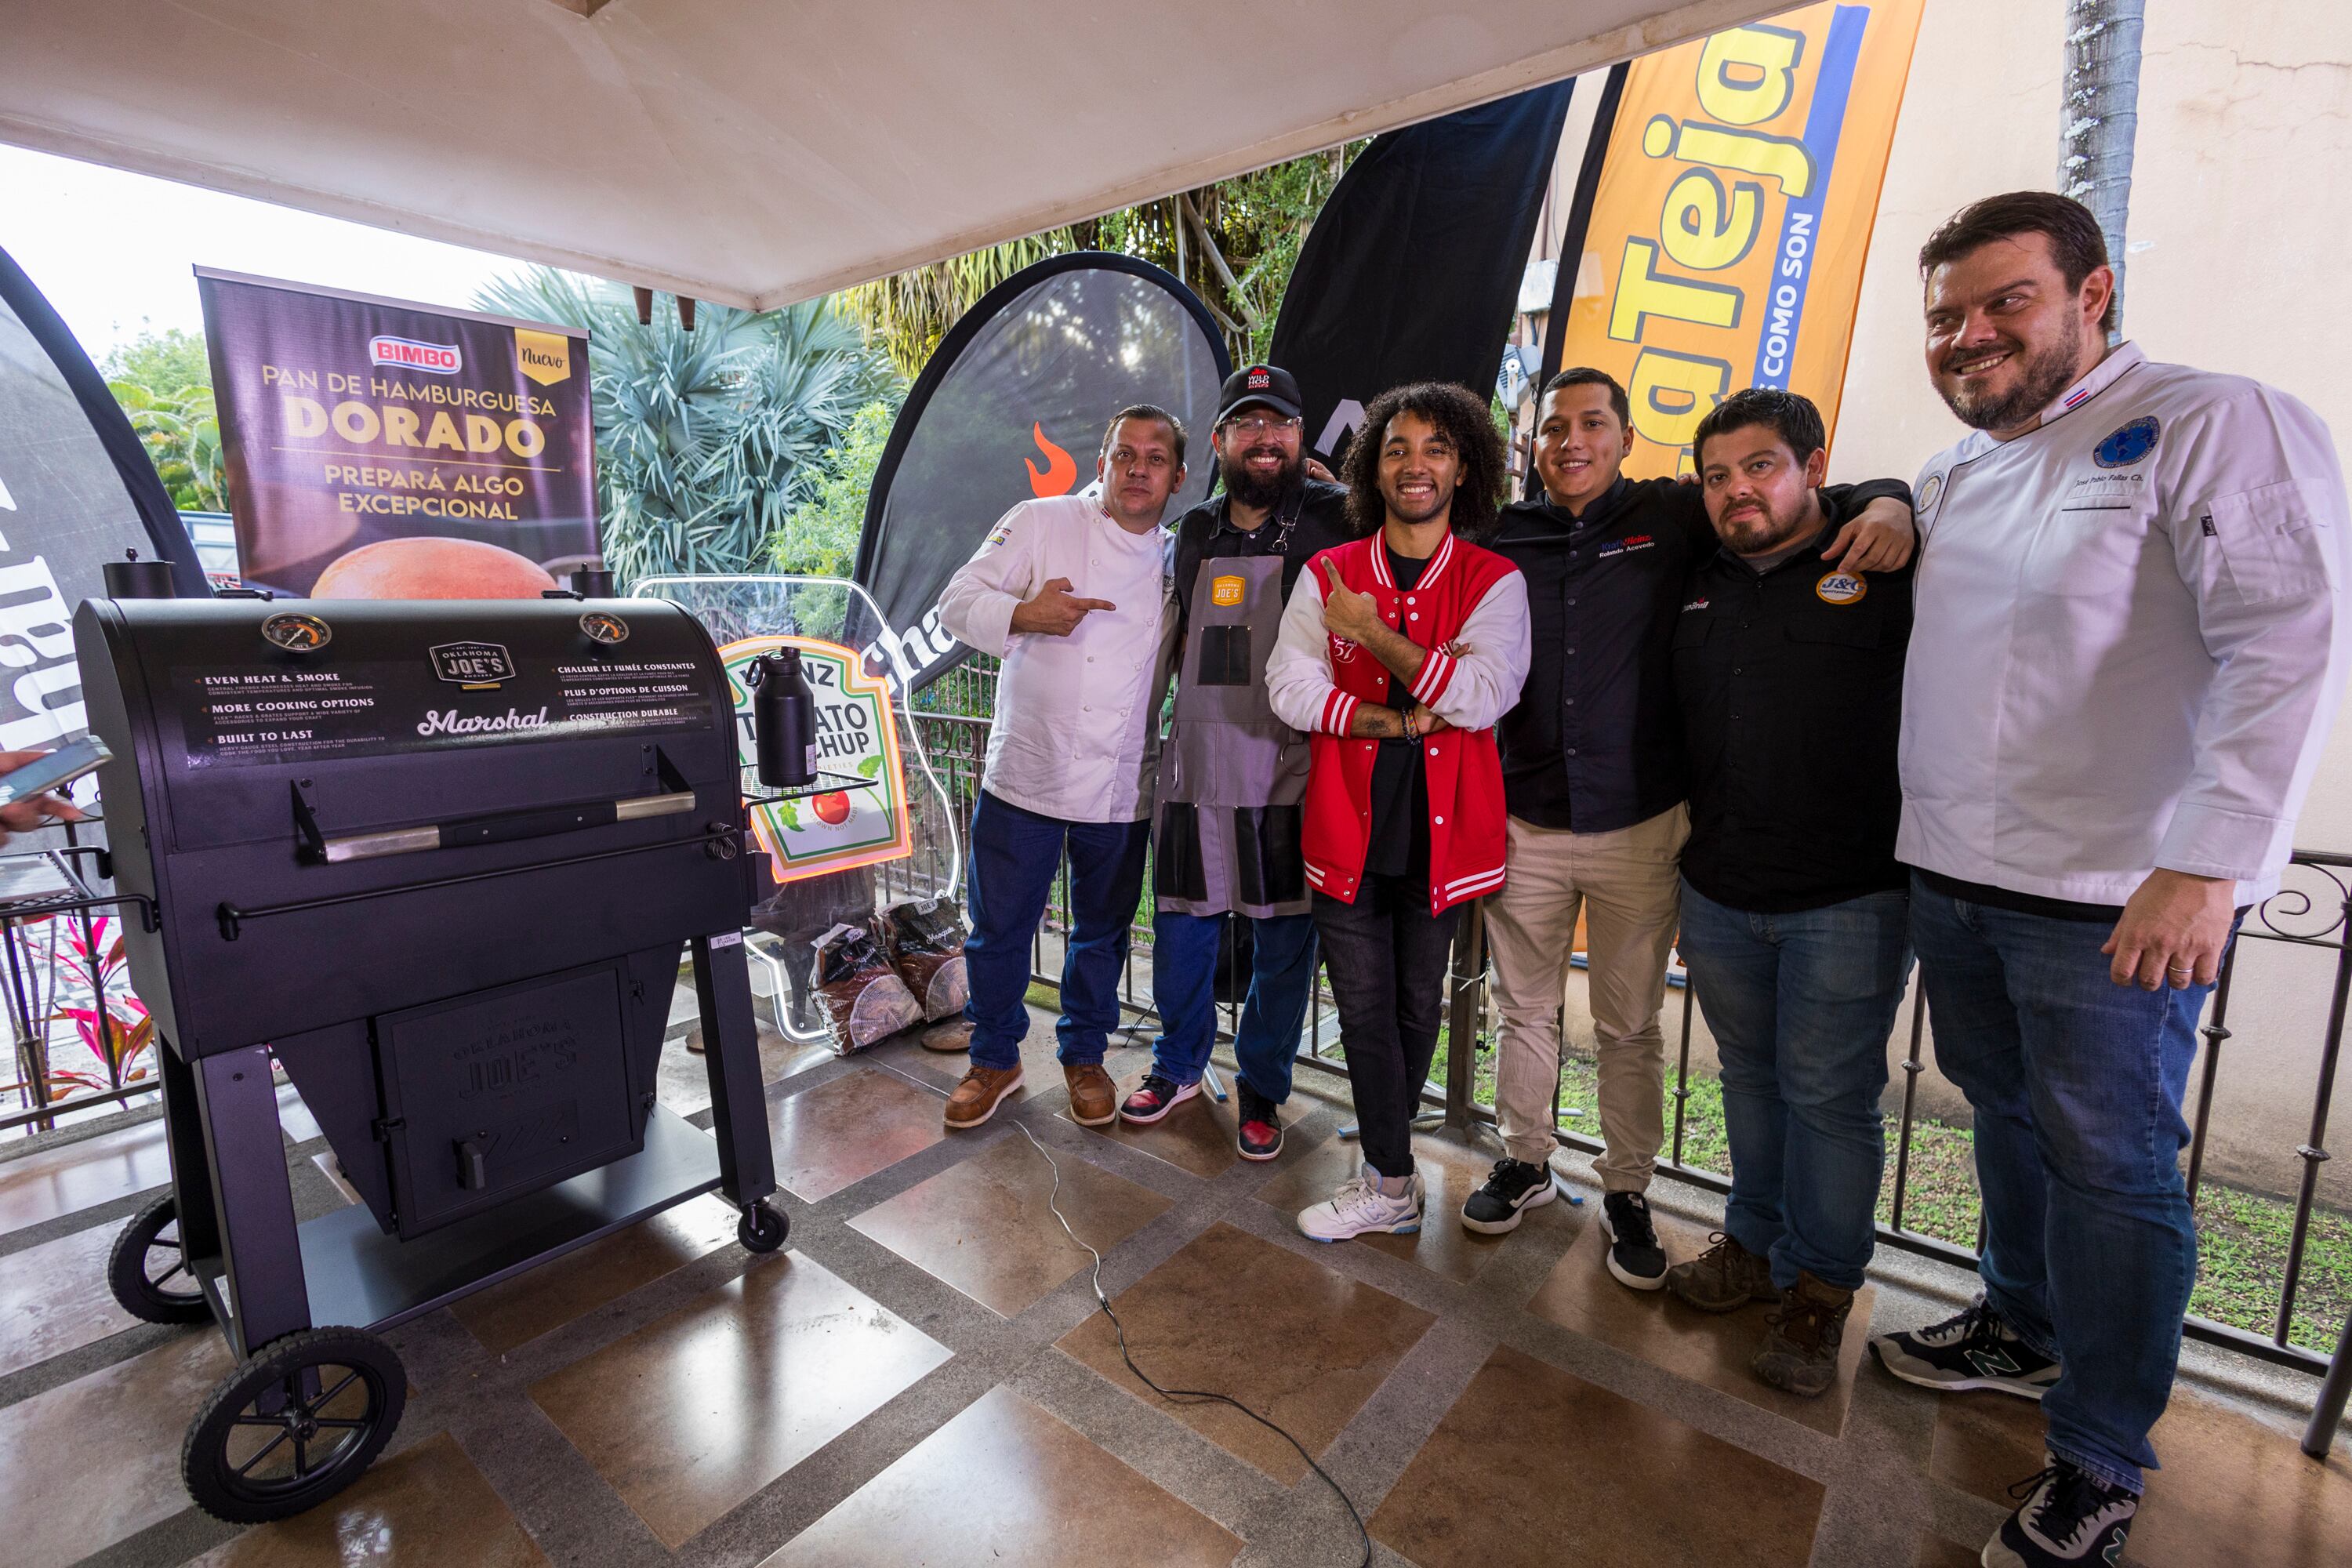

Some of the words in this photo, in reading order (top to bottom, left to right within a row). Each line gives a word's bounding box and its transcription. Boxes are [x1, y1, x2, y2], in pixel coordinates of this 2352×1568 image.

[1763, 284, 1796, 378] COMO
[1781, 213, 1813, 279] SON
[377, 343, 456, 368] BIMBO
[521, 347, 566, 368] Nuevo
[263, 365, 318, 390] PAN
[328, 373, 363, 395] DE
[372, 378, 557, 416] HAMBURGUESA
[284, 395, 546, 458] DORADO
[325, 465, 445, 491] PREPARÁ
[454, 474, 524, 496] ALGO
[339, 492, 518, 521] EXCEPCIONAL
[1599, 548, 1624, 558] Rolando
[1626, 542, 1654, 552] Acevedo
[1216, 589, 1239, 598] JOE'S
[442, 650, 499, 659] OKLAHOMA
[1334, 641, 1356, 660] 57
[447, 658, 505, 675] JOE'S
[244, 675, 276, 684] HEAT
[296, 673, 340, 682] SMOKE
[589, 687, 637, 695] D'OPTIONS
[212, 703, 252, 713] MORE
[256, 700, 318, 711] COOKING
[321, 698, 375, 708] OPTIONS
[569, 711, 638, 721] CONSTRUCTION
[641, 708, 678, 717] DURABLE
[417, 706, 550, 736] Marshal
[736, 702, 868, 741] TATO
[217, 734, 255, 744] BUILT
[259, 732, 278, 742] TO
[282, 730, 313, 740] LAST
[920, 901, 936, 911] JOE'S
